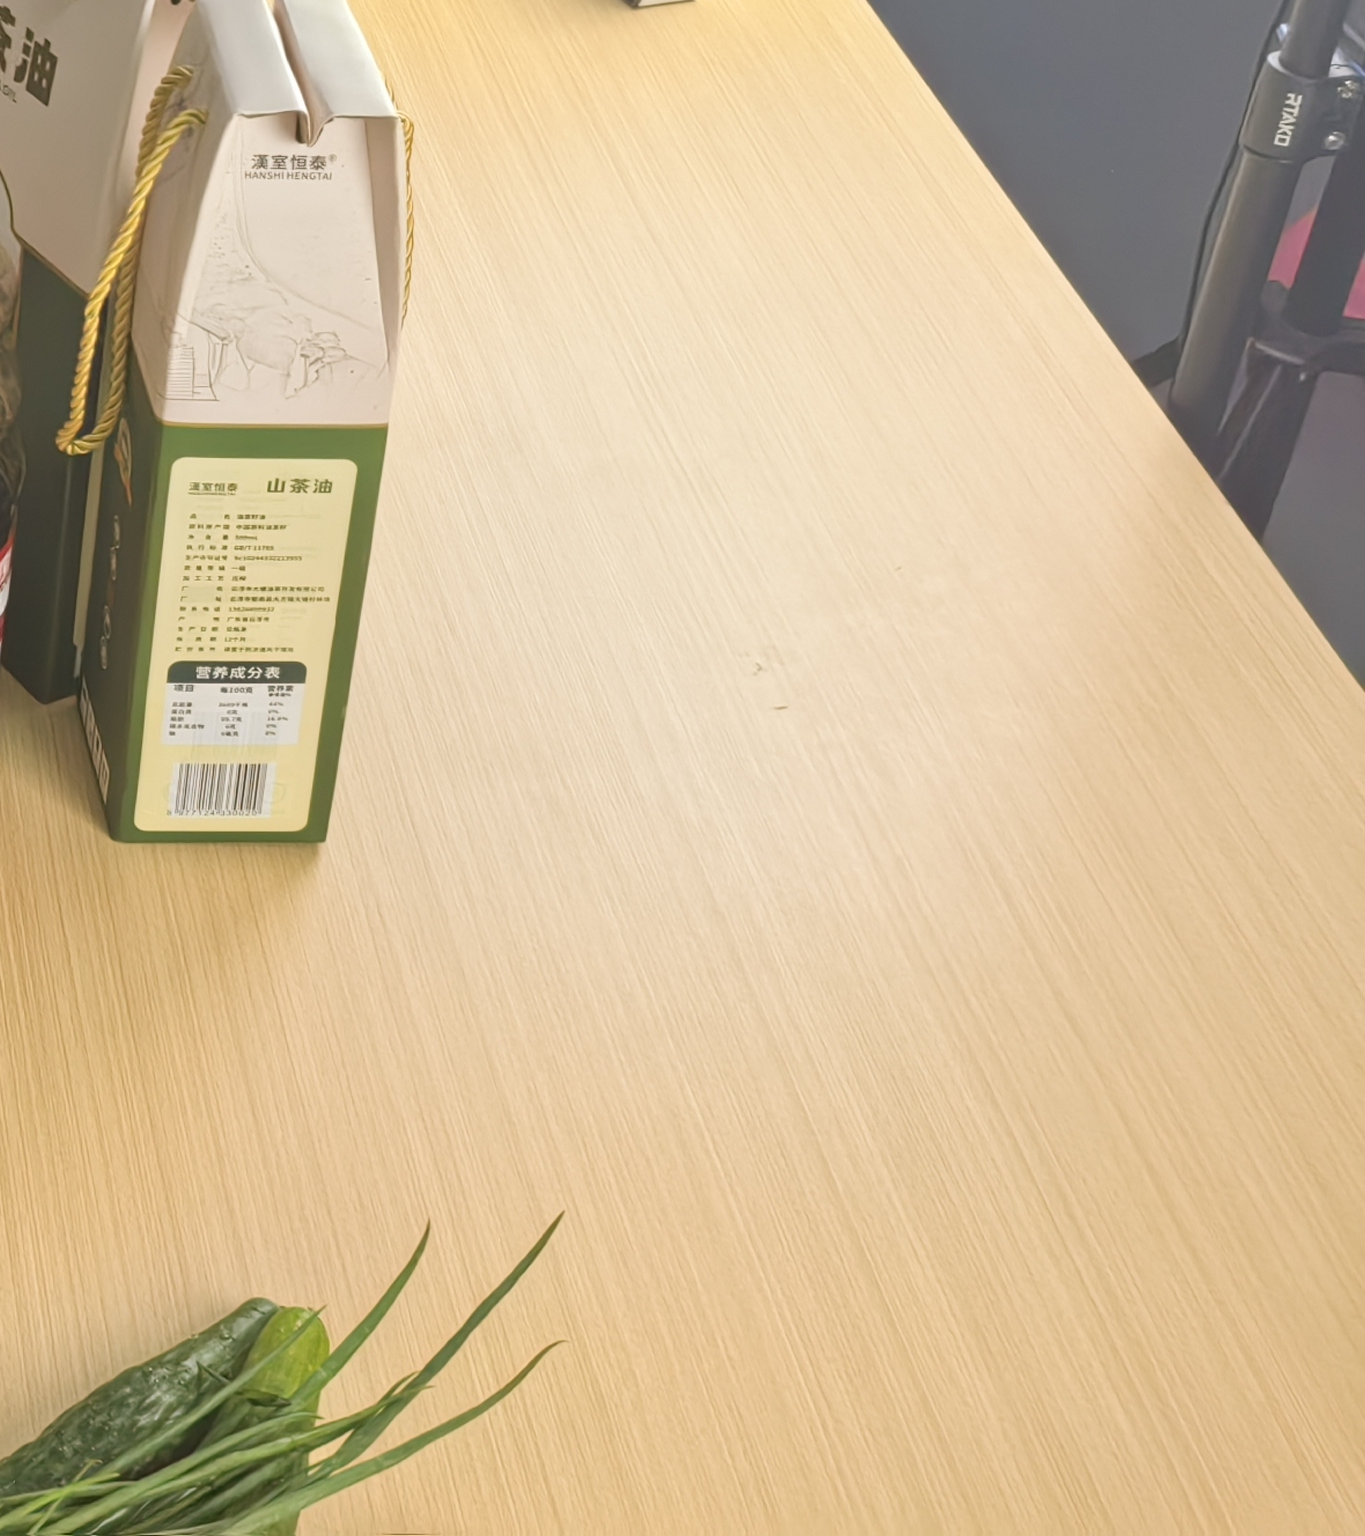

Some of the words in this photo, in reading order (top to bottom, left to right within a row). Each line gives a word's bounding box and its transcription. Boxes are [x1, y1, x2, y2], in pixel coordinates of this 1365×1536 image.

[244, 171, 285, 180] HANSHI
[286, 171, 332, 181] HENGTAI
[267, 478, 333, 494] 山茶油
[196, 666, 280, 680] 营养成分表
